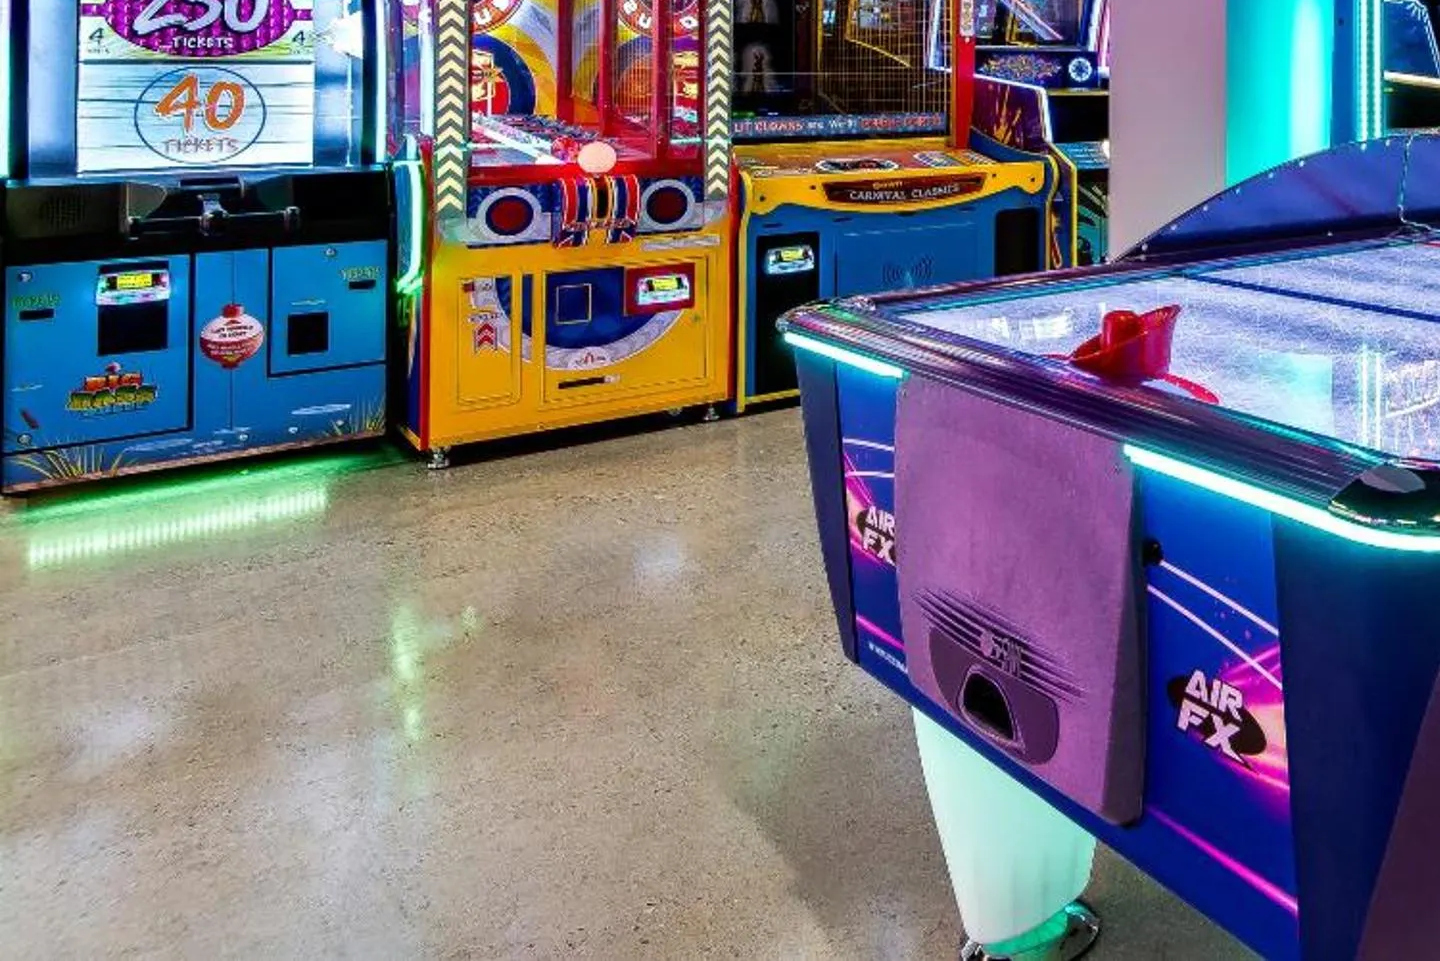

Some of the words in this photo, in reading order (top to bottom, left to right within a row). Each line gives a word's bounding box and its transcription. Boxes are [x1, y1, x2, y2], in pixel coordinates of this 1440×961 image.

[172, 36, 234, 49] TICKETS
[155, 72, 246, 133] 40
[161, 136, 240, 156] TICKETS
[850, 189, 906, 201] CARNIVAL
[867, 505, 896, 537] AIR
[863, 526, 896, 567] FX
[1185, 669, 1243, 722] AIR
[1177, 698, 1245, 764] FX
